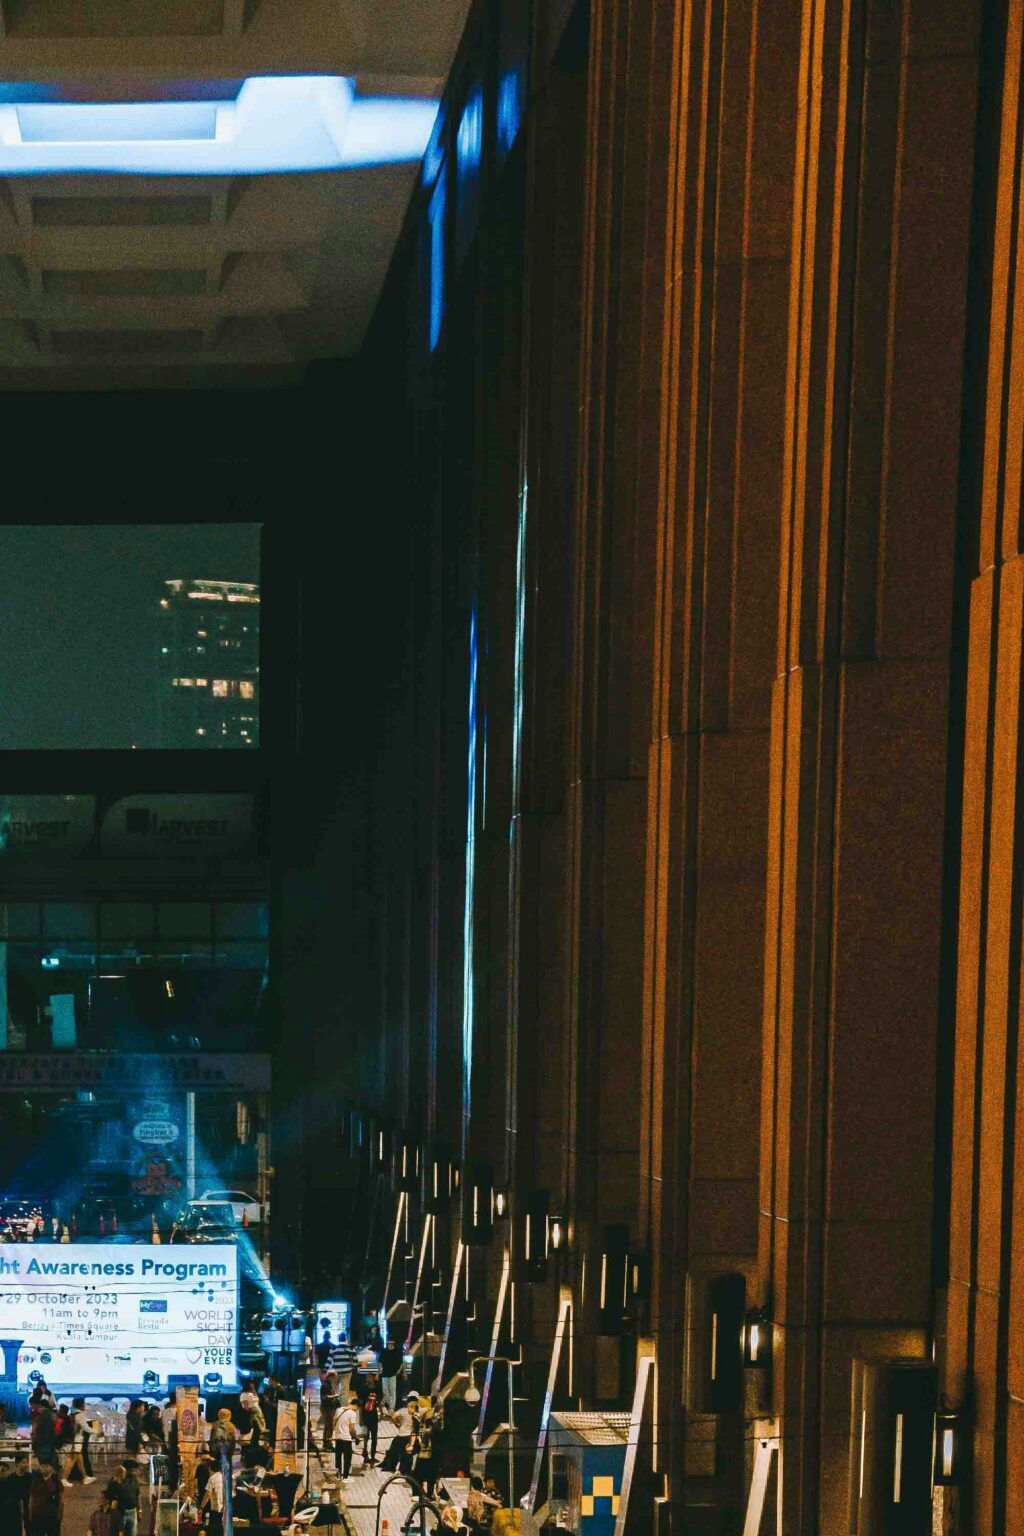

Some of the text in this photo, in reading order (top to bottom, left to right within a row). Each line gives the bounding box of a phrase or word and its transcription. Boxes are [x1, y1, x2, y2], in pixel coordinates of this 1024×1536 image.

[26, 1258, 134, 1276] Awareness
[141, 1259, 226, 1281] Program
[5, 1293, 22, 1304] 29
[27, 1293, 81, 1305] October
[85, 1293, 118, 1305] 2023
[42, 1307, 118, 1321] 11am to 9pm
[184, 1310, 234, 1320] WORLD
[58, 1321, 85, 1330] Times
[87, 1321, 119, 1332] Square
[196, 1322, 234, 1332] SIGHT
[84, 1333, 119, 1343] Lumpur
[207, 1335, 233, 1345] DAY
[204, 1348, 233, 1356] YOUR
[204, 1356, 232, 1365] EYES
